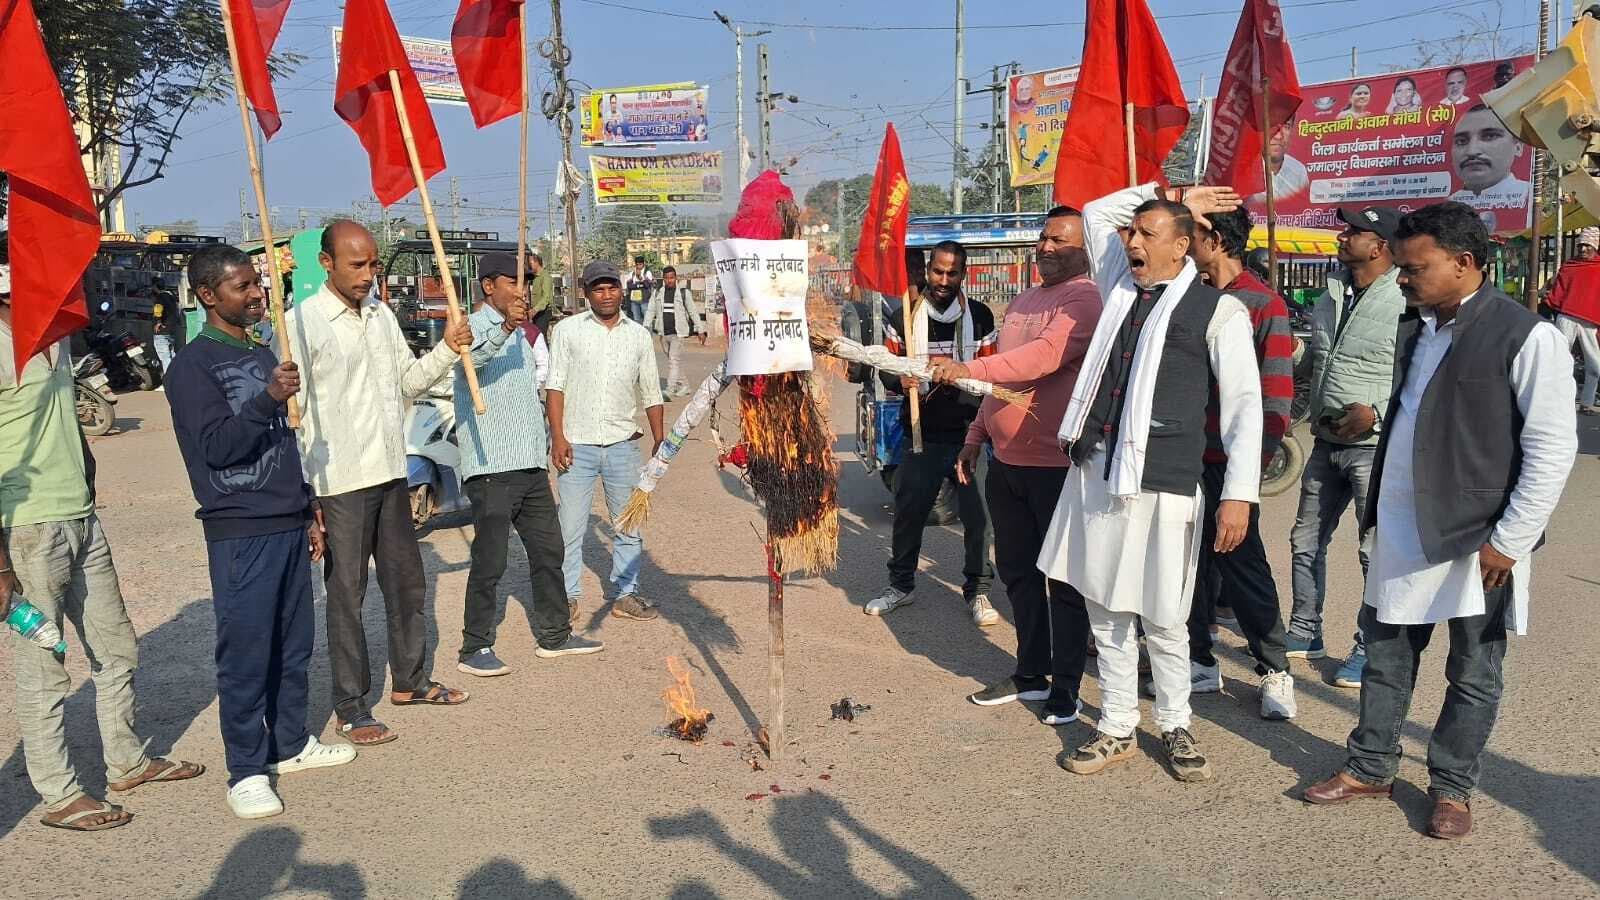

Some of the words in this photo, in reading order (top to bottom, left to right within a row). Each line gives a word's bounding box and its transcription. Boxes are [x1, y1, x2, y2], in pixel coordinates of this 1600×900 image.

[1298, 114, 1353, 140] हिन्दुस्तानी
[1356, 115, 1388, 130] अवाम
[1392, 106, 1422, 125] मोर्चा
[1311, 141, 1335, 156] जिला
[1382, 134, 1424, 150] सम्मेलन
[1426, 130, 1444, 147] एवं
[608, 156, 637, 170] HARI
[641, 155, 658, 168] OM
[663, 152, 720, 168] ACADEMY
[1306, 159, 1348, 175] जमालपुर
[1350, 155, 1399, 170] विधानसभा
[1402, 150, 1446, 166] सम्मेलन
[1293, 208, 1336, 227] अतिथियों
[740, 252, 761, 272] मंत्री
[766, 253, 804, 279] मुर्दाबाद
[738, 313, 757, 341] मंत्री
[763, 312, 803, 351] मुर्दाबाद
